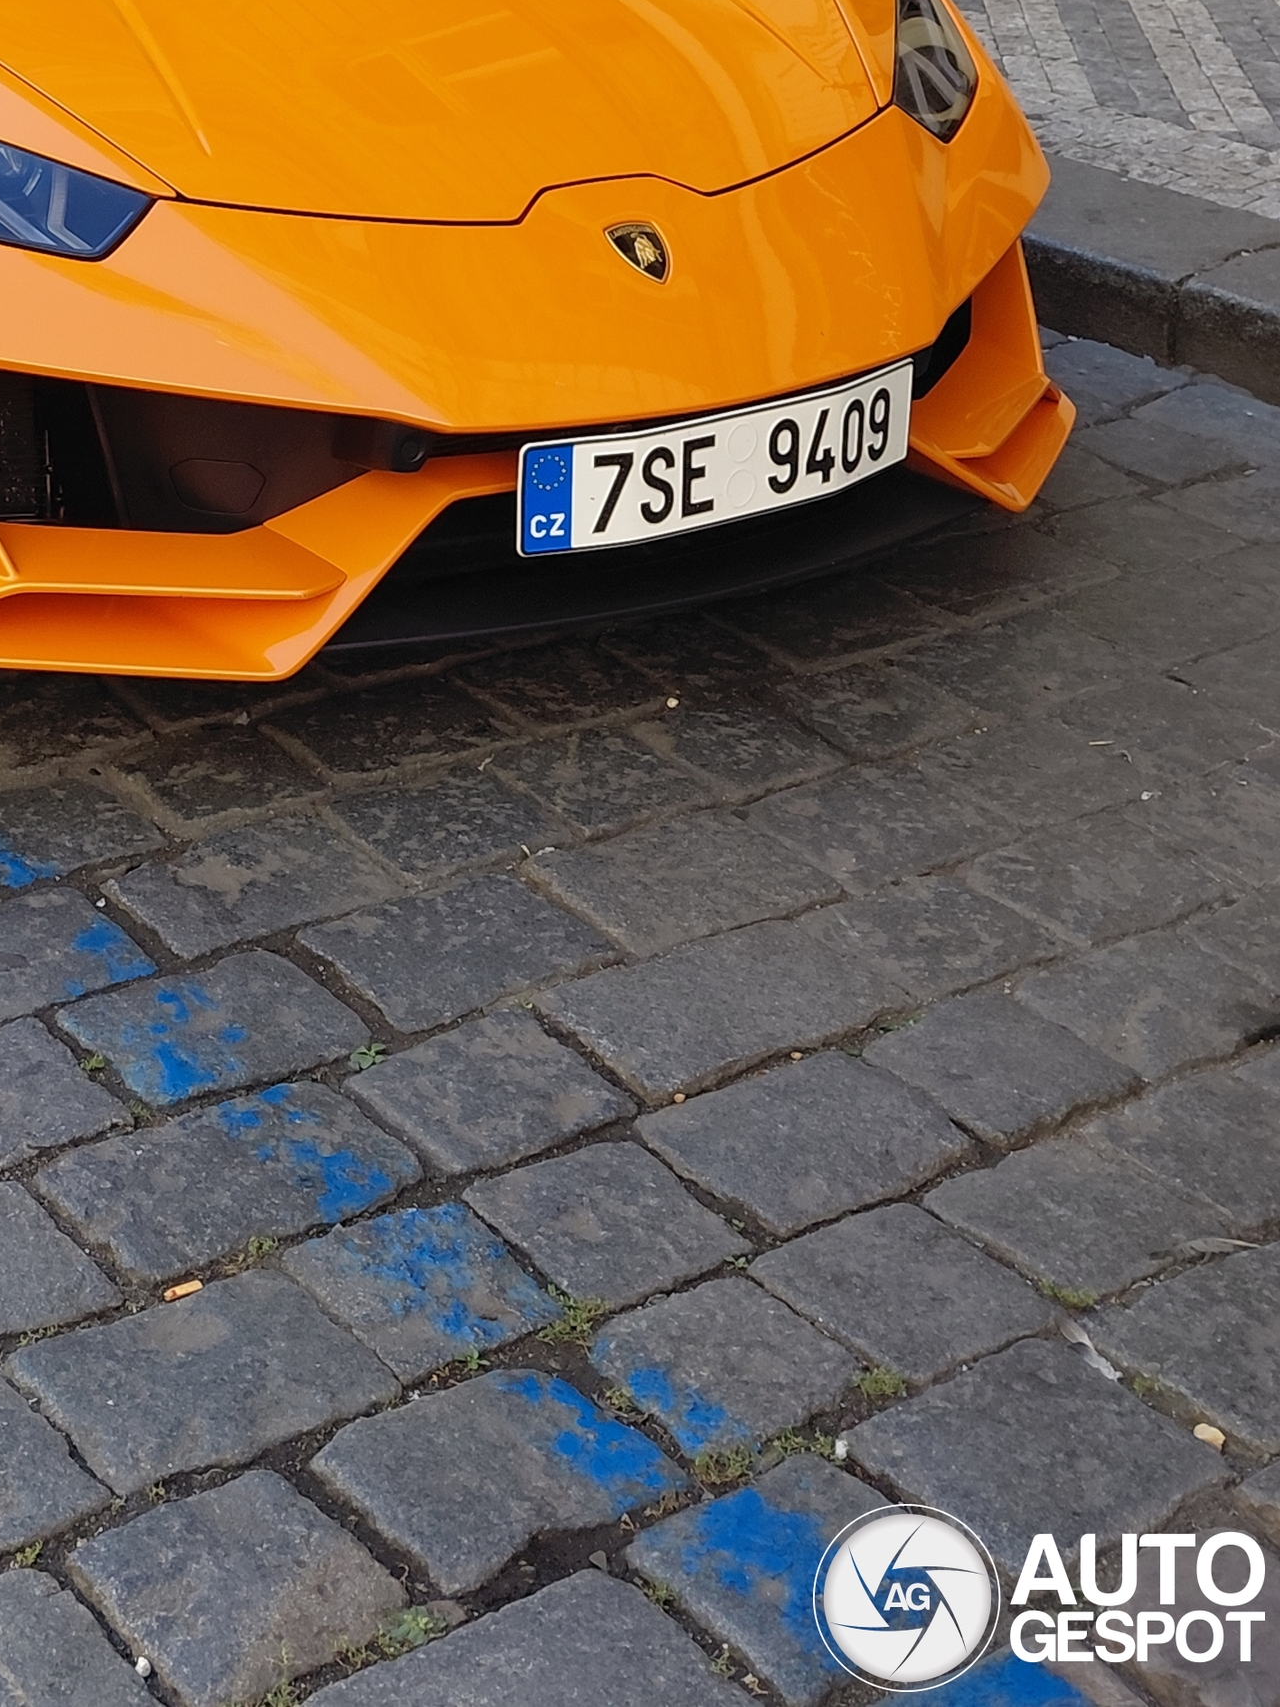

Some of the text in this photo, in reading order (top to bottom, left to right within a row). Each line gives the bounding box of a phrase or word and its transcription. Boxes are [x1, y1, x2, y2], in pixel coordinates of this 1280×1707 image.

[592, 387, 891, 534] 7SE 9409
[529, 512, 566, 539] CZ
